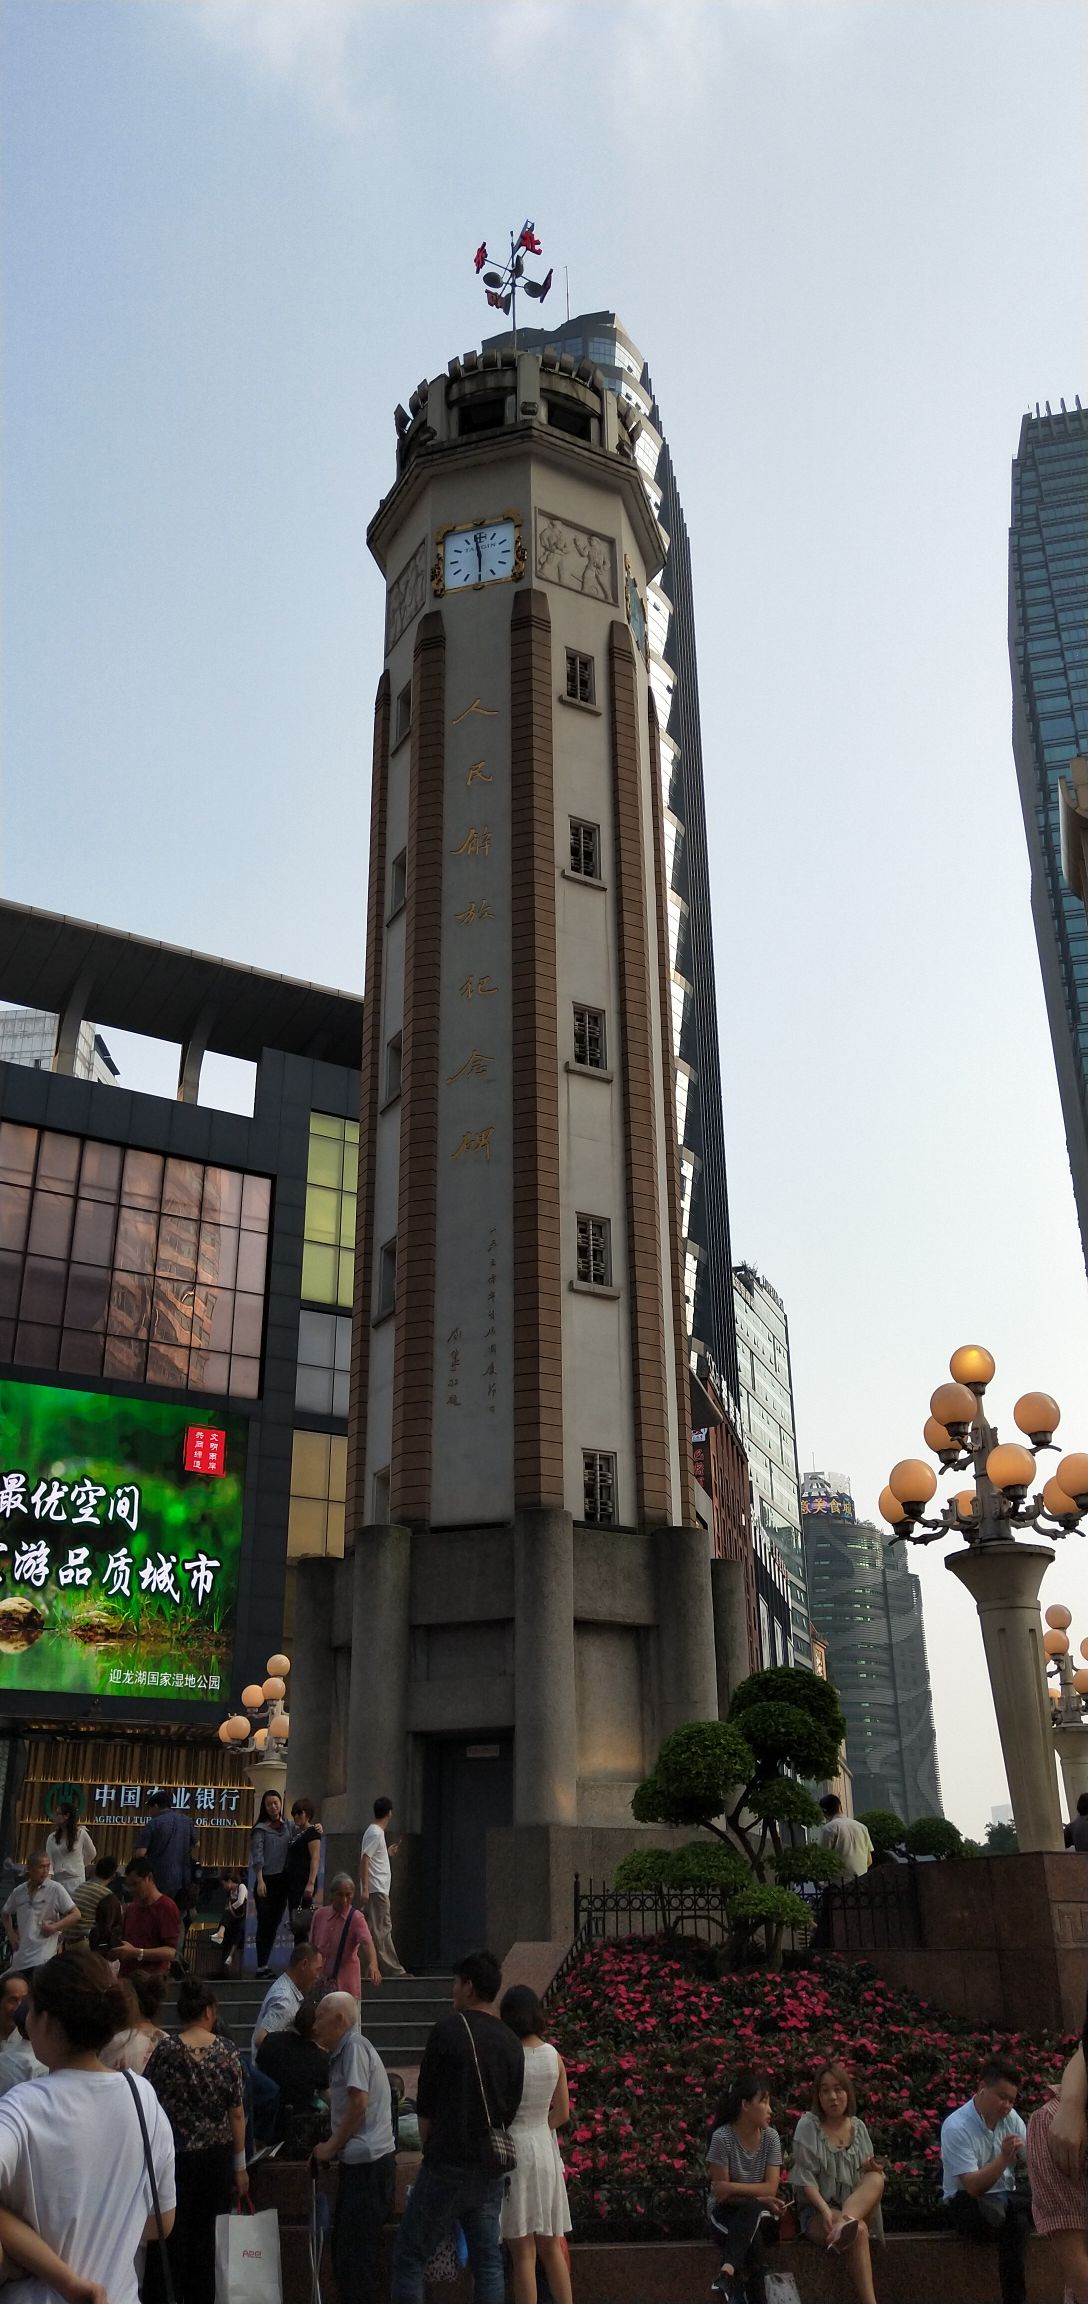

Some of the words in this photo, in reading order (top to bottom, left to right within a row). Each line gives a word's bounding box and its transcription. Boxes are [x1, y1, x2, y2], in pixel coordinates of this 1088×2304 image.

[207, 1433, 220, 1471] 文明南岸
[109, 1668, 221, 1690] 迎龙湖国家湿地公园
[195, 1817, 209, 1825] OF
[211, 1818, 238, 1827] CHINA
